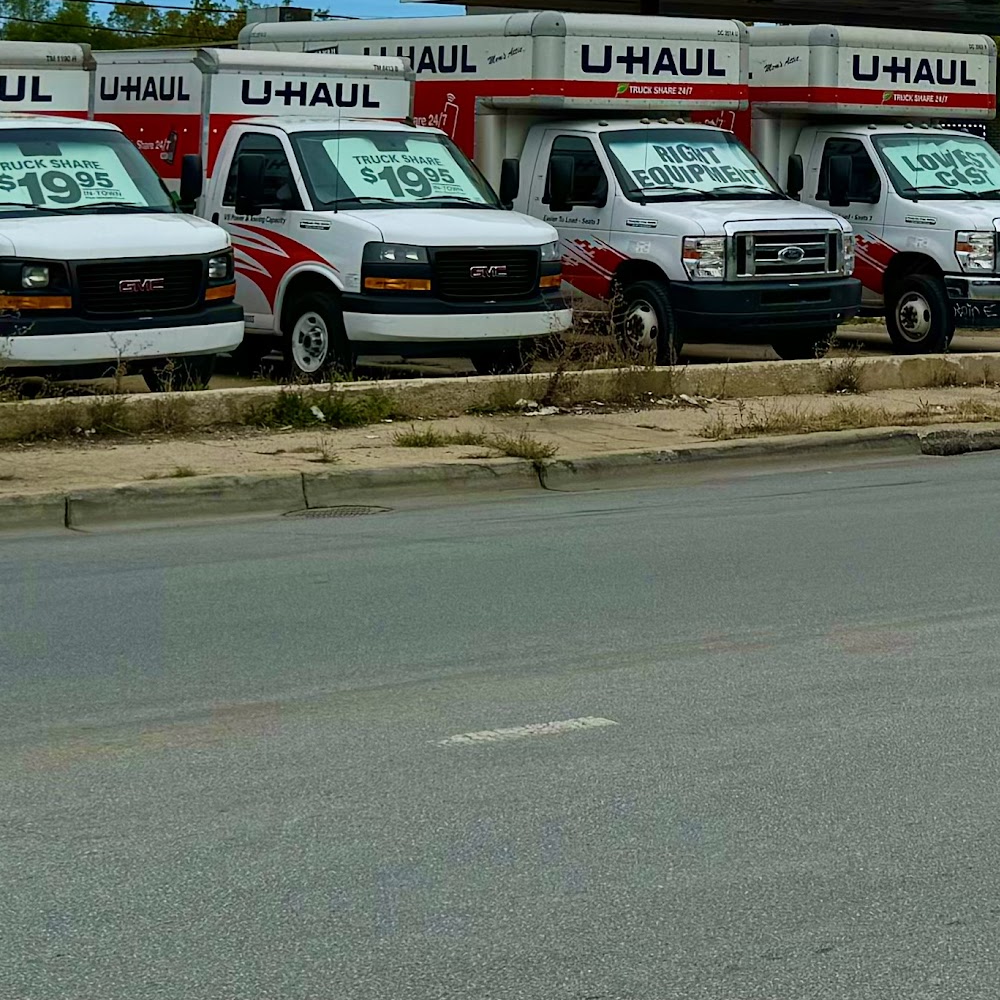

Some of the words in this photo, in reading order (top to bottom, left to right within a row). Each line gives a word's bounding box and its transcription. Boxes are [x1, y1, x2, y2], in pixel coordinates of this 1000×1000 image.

[364, 44, 477, 74] HAUL
[581, 44, 726, 77] U-HAUL
[852, 54, 976, 87] U-HAUL
[100, 76, 190, 101] U-HAUL
[241, 79, 380, 108] U-HAUL
[629, 85, 653, 94] TRUCK
[653, 86, 677, 95] SHARE
[678, 86, 693, 96] 24/7
[893, 93, 914, 102] TRUCK
[914, 94, 934, 103] SHARE
[428, 112, 448, 128] 24/7
[352, 154, 399, 165] TRUCK
[403, 155, 444, 166] SHARE
[653, 143, 722, 165] RIGHT
[901, 148, 995, 172] LOWEST
[0, 159, 49, 171] RUCK
[50, 159, 104, 170] SHARE
[631, 164, 764, 187] EQUIPMENT
[935, 166, 995, 187] COST
[469, 265, 508, 278] GMC
[119, 277, 165, 292] GMC
